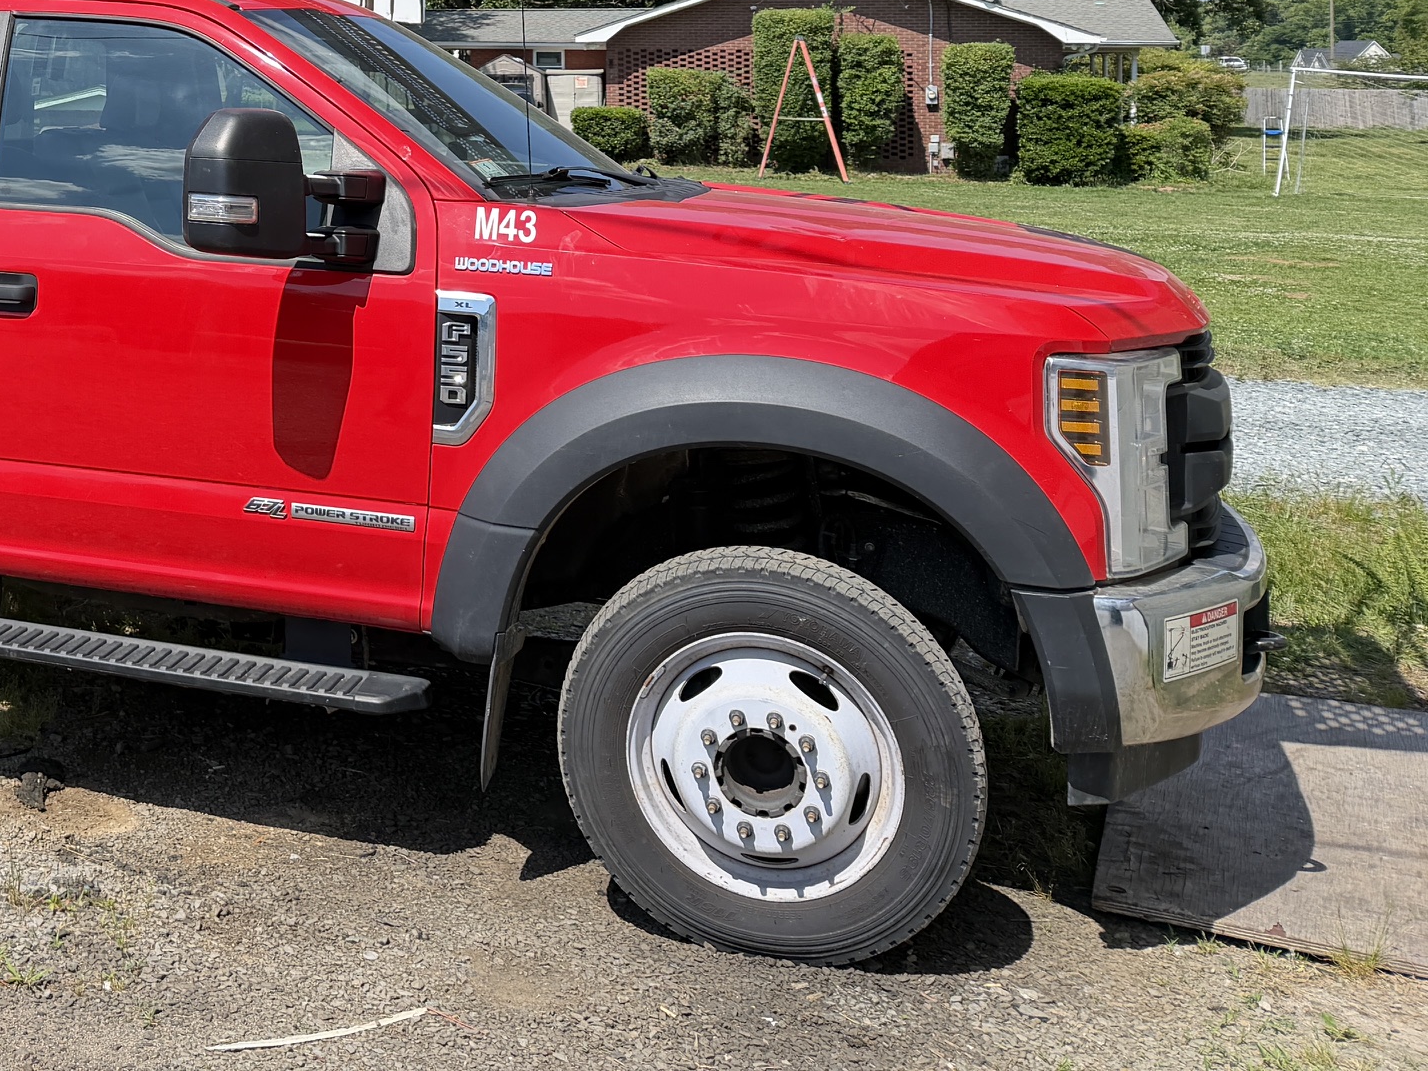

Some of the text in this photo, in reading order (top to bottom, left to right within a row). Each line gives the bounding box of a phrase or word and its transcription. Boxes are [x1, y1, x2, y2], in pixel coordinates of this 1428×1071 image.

[474, 206, 537, 244] M43
[454, 256, 553, 277] WOODHOUSE
[454, 301, 473, 309] XL
[294, 504, 411, 527] POWER STROKE
[1207, 607, 1228, 621] DANGER
[783, 612, 863, 663] YOKOHAMA
